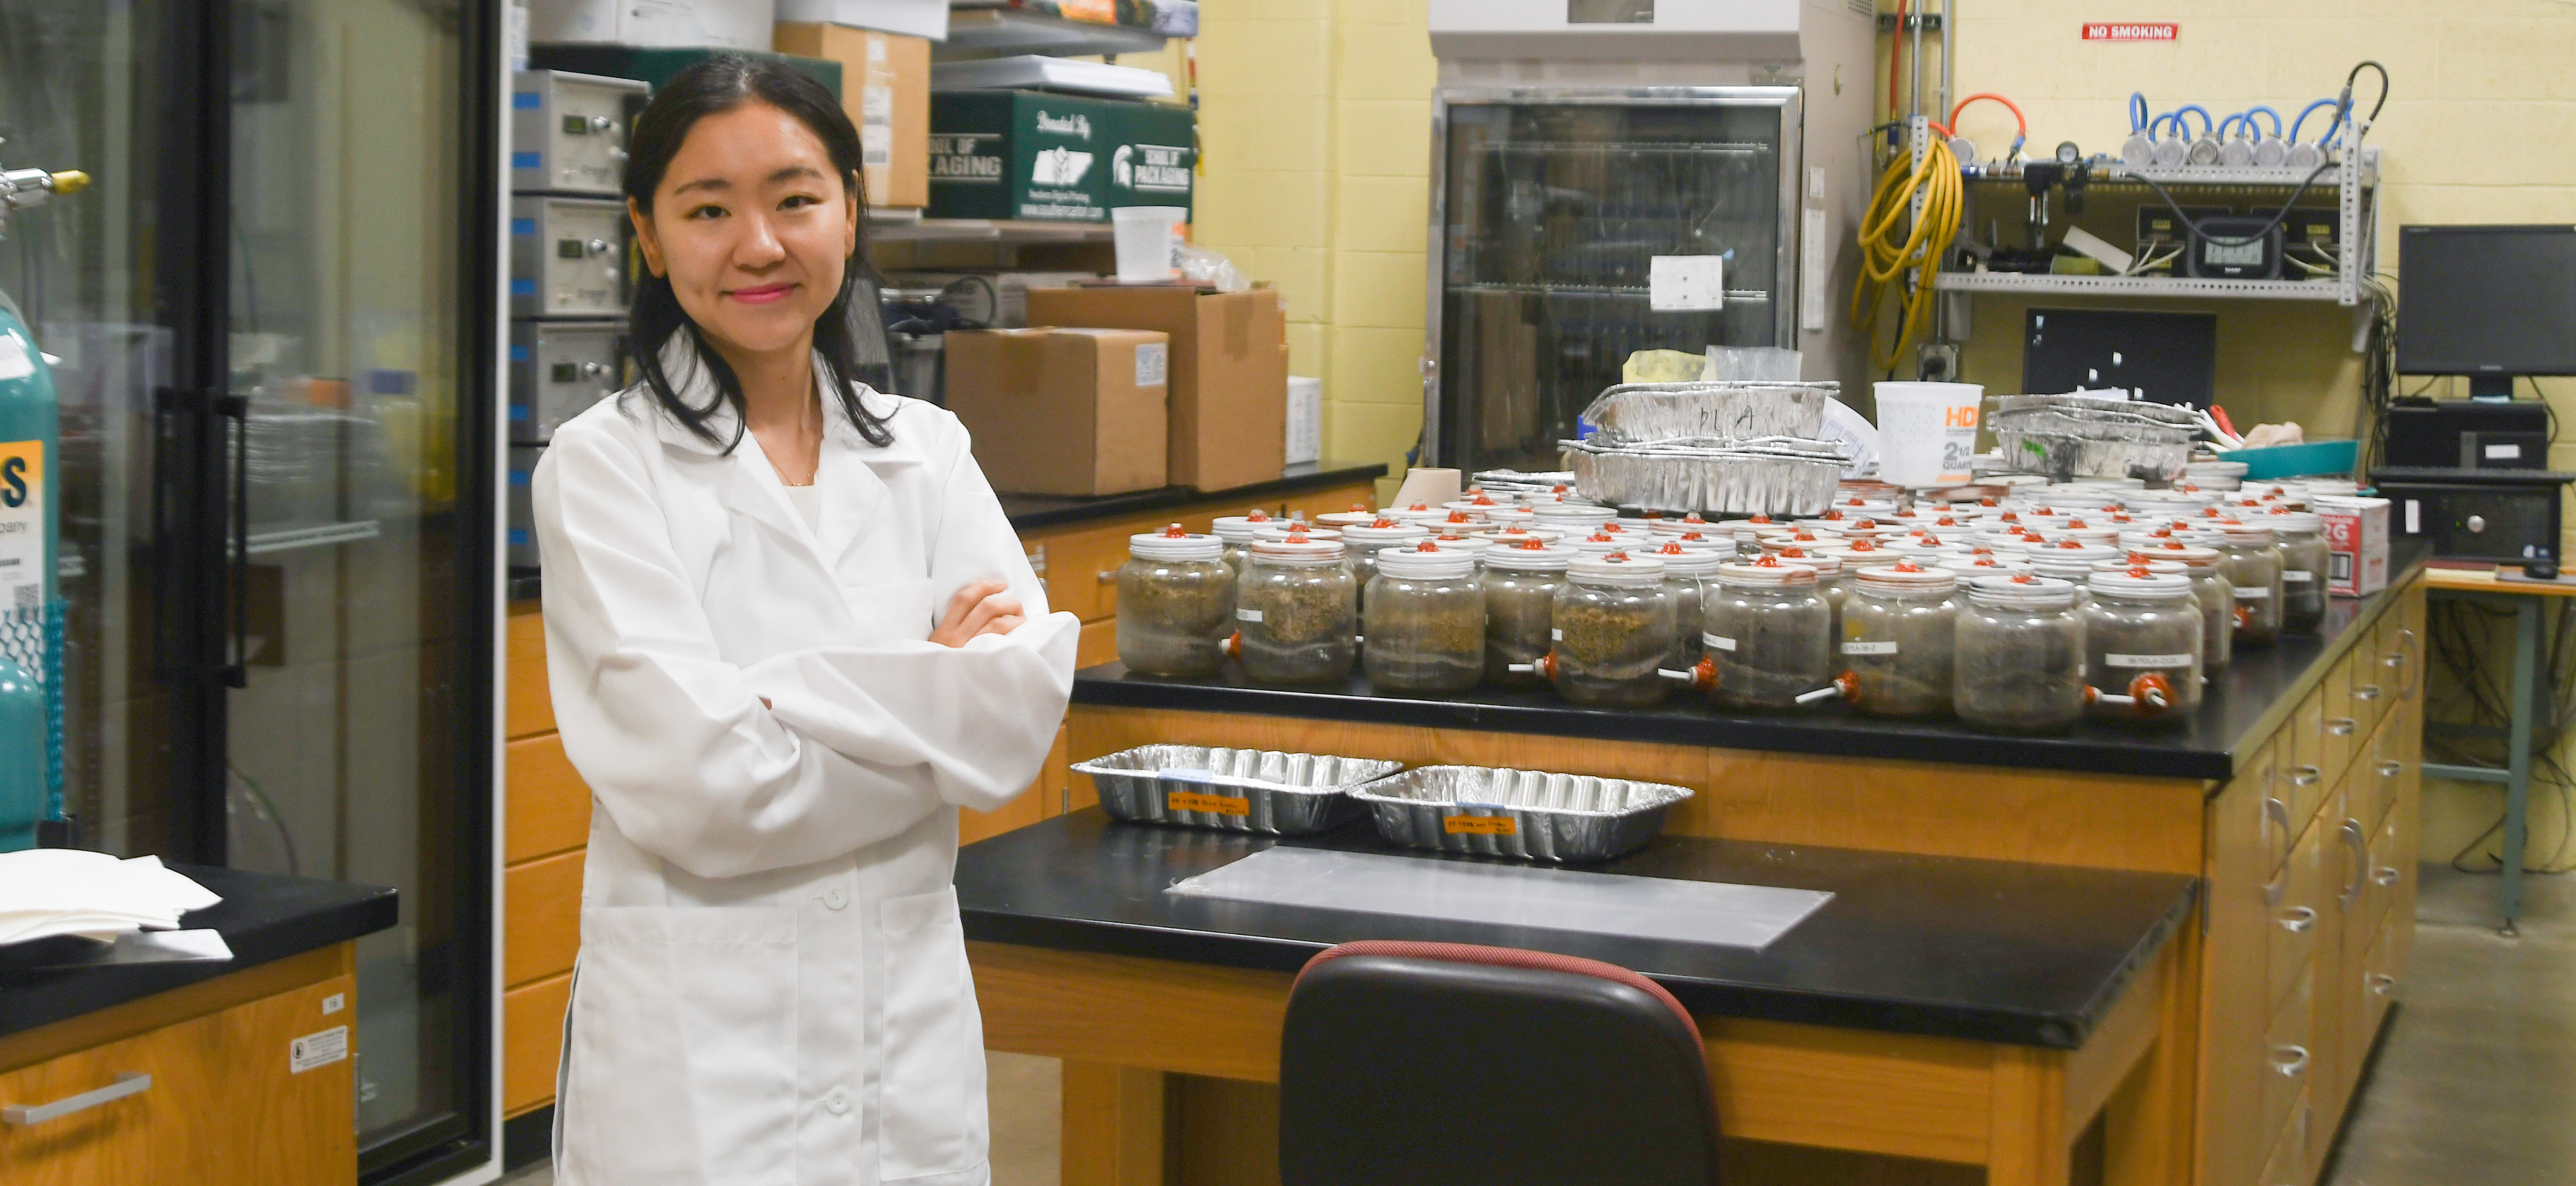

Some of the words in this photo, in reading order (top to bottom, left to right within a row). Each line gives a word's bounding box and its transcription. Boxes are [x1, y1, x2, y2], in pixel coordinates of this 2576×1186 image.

[2089, 25, 2108, 37] NO
[2111, 25, 2172, 38] SMOKING
[929, 155, 1002, 175] AGING
[1943, 441, 1958, 460] 2
[1958, 446, 1970, 457] 1/2
